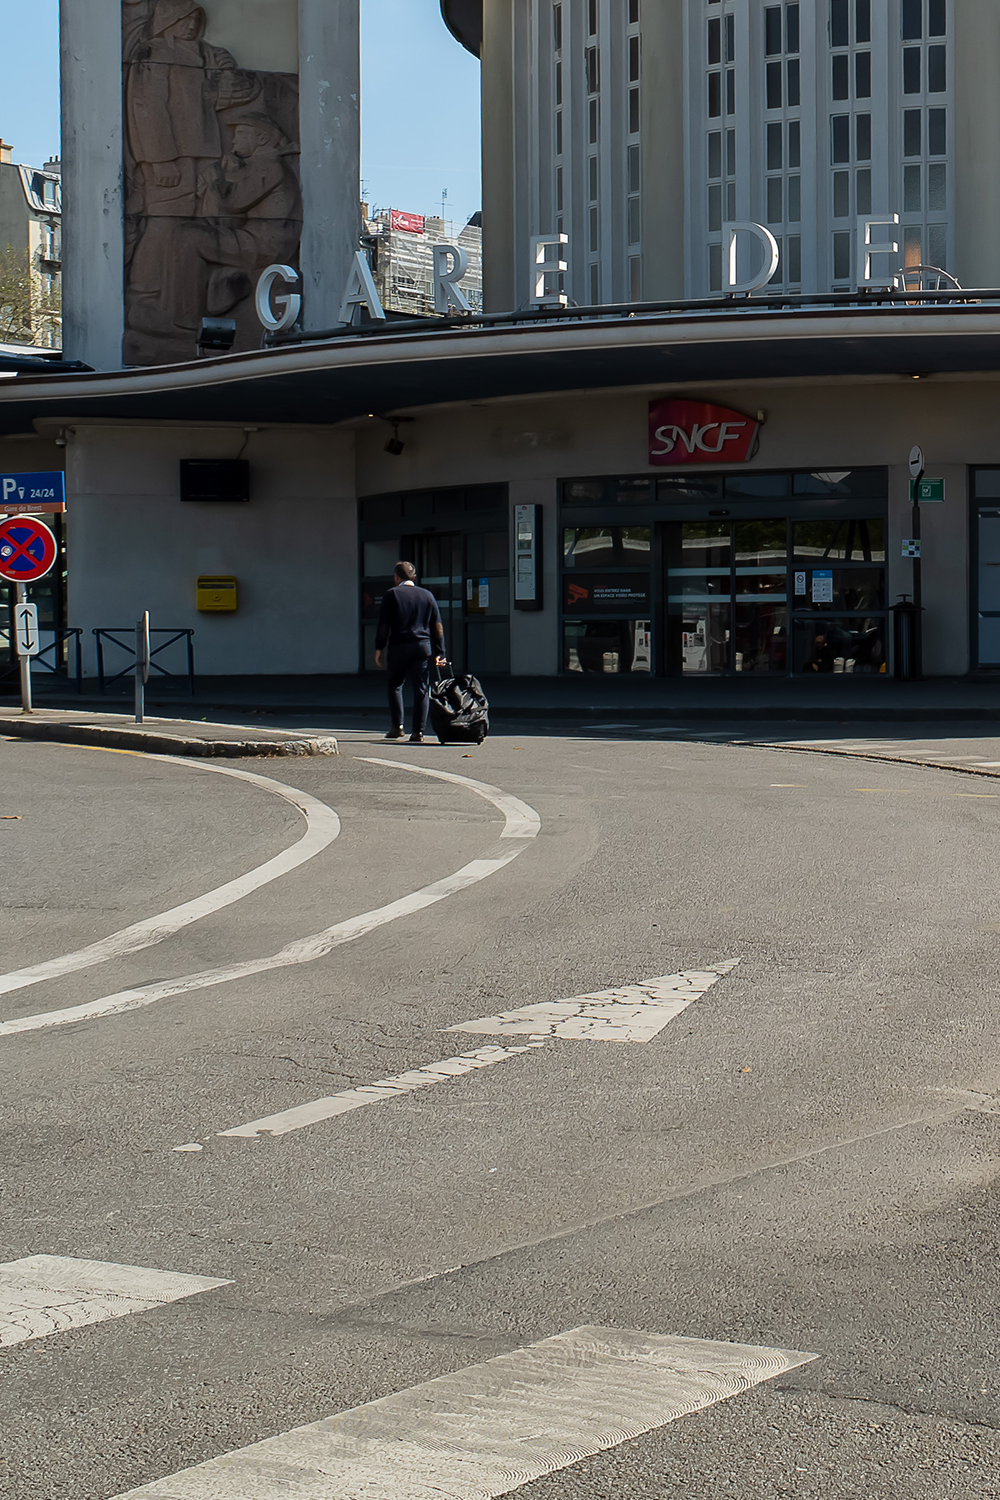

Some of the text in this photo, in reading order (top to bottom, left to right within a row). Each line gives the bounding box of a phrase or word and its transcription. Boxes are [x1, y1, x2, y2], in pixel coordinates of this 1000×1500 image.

[255, 233, 569, 332] GARE
[722, 212, 899, 293] DE
[651, 421, 747, 455] SNCF
[3, 478, 55, 500] P 24/24
